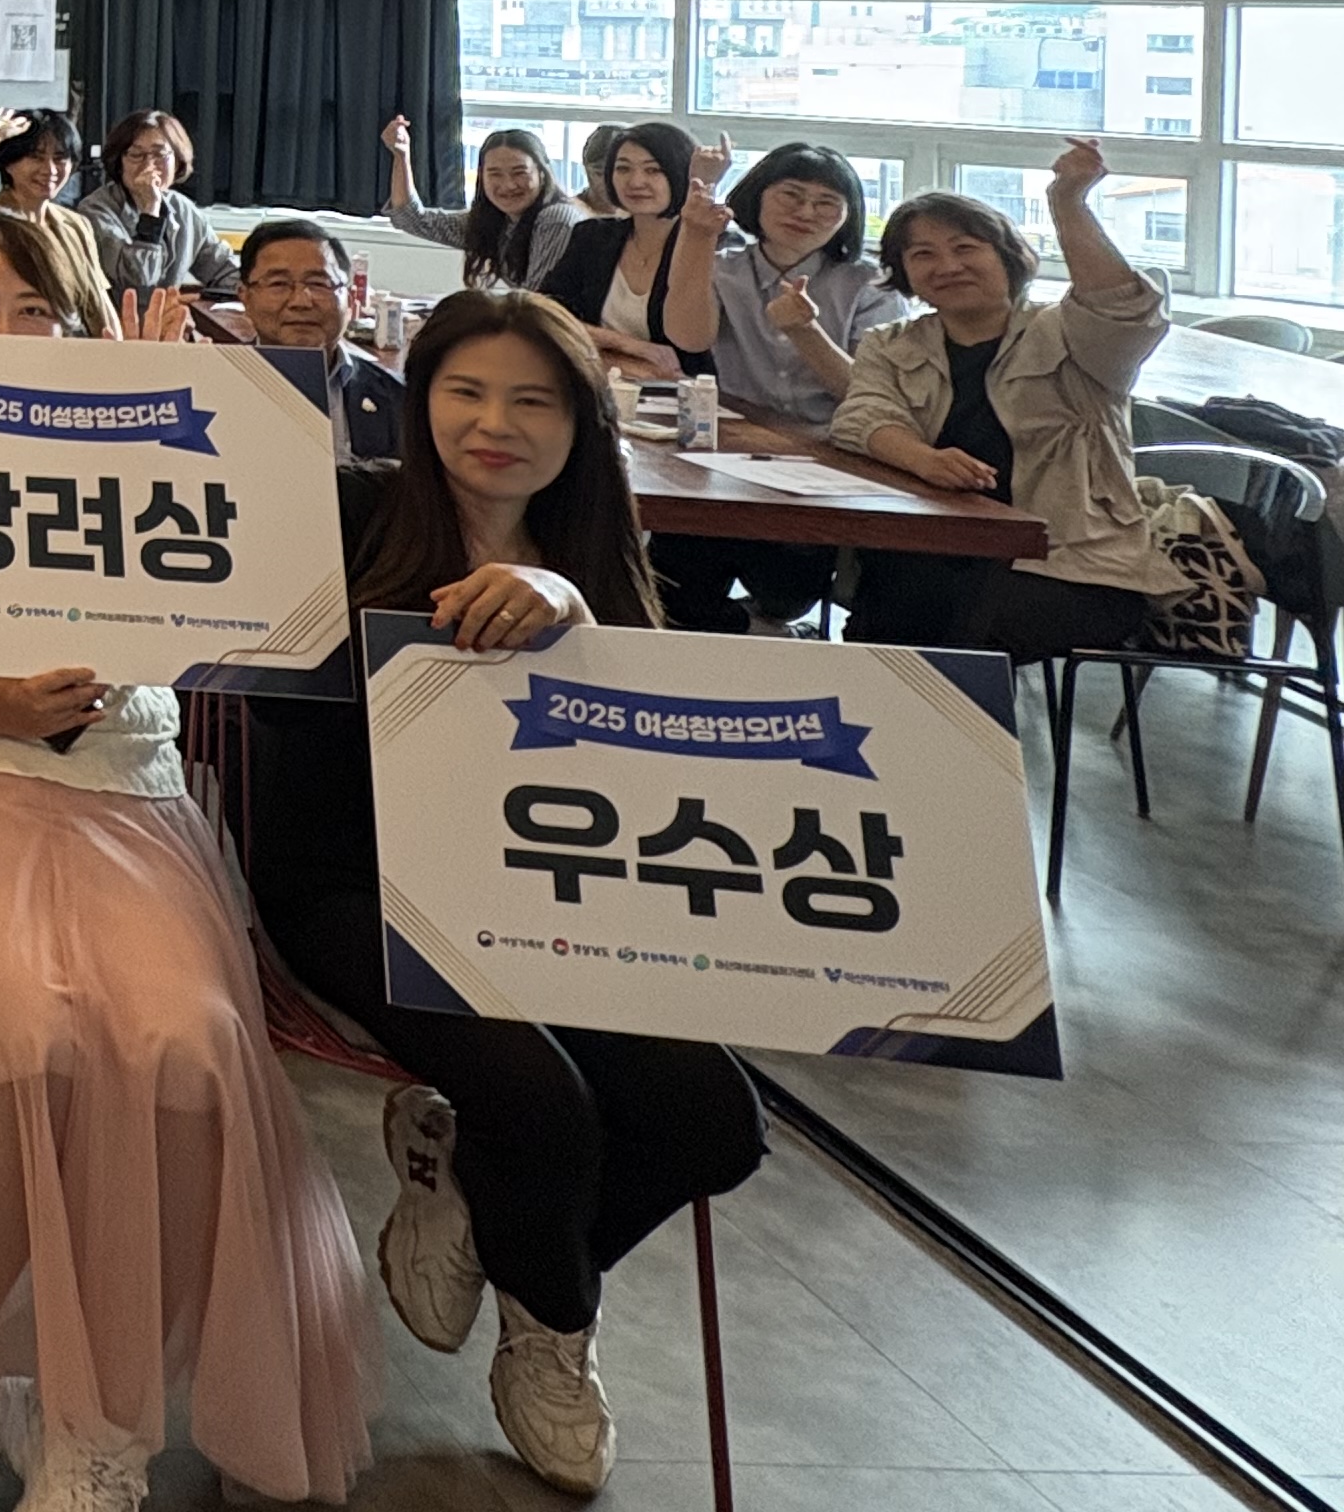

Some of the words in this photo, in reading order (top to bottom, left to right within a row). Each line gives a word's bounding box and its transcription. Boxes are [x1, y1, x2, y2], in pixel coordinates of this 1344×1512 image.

[30, 400, 179, 430] 여성창업오디션
[547, 693, 627, 733] 2025
[634, 708, 825, 743] 여성창업오디션
[502, 783, 905, 933] 우수상
